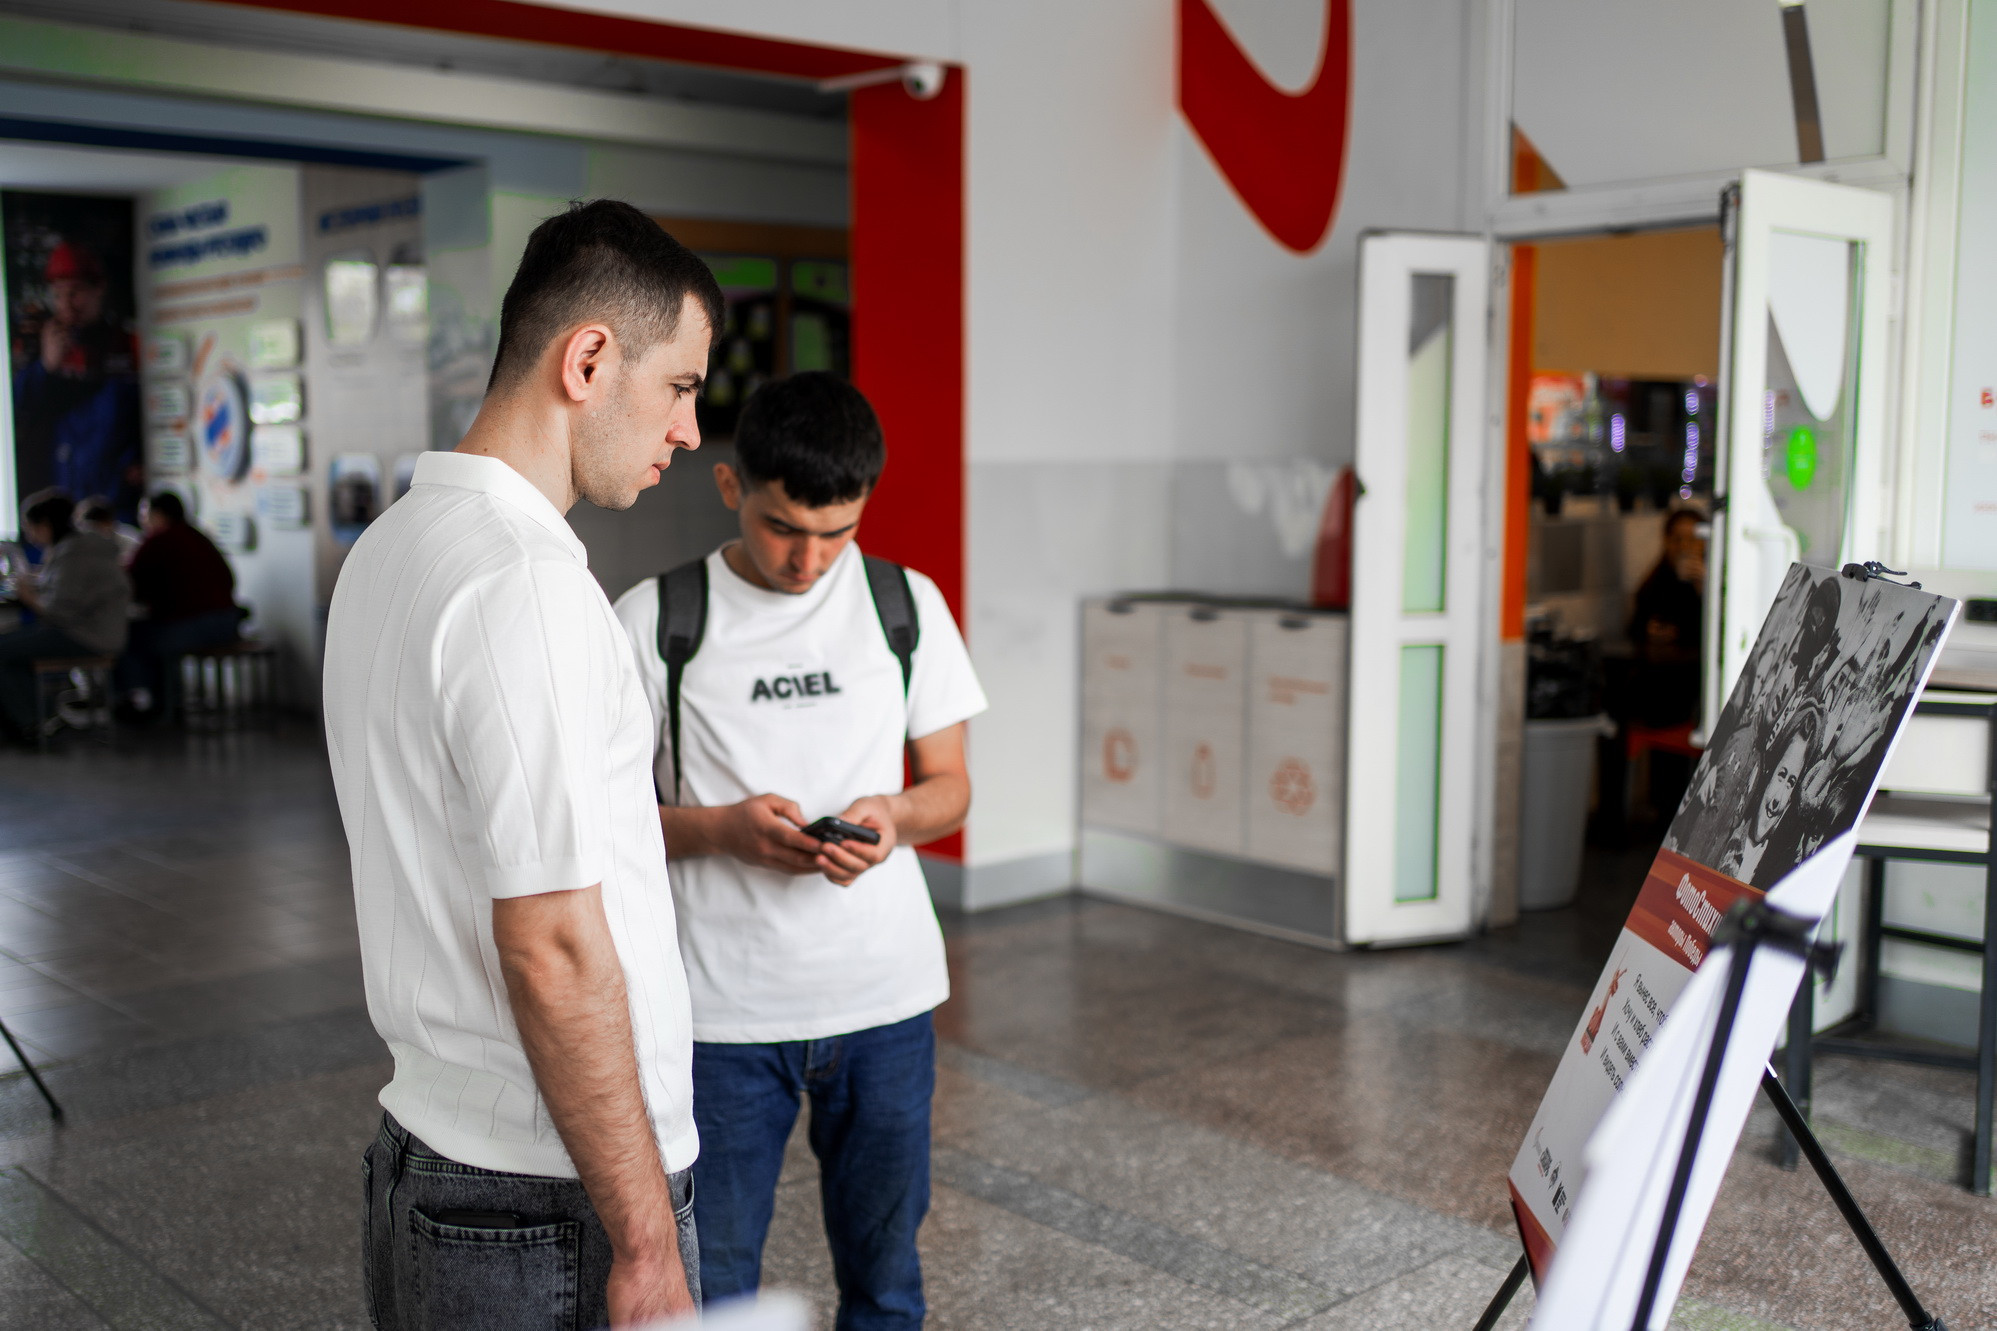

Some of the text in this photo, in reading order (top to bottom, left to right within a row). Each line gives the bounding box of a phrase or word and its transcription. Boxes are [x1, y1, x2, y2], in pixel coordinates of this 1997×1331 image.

[1633, 973, 1642, 988] Я
[1636, 982, 1651, 1004] вынес
[1621, 997, 1633, 1023] Хочу
[1632, 1021, 1647, 1039] хлеб
